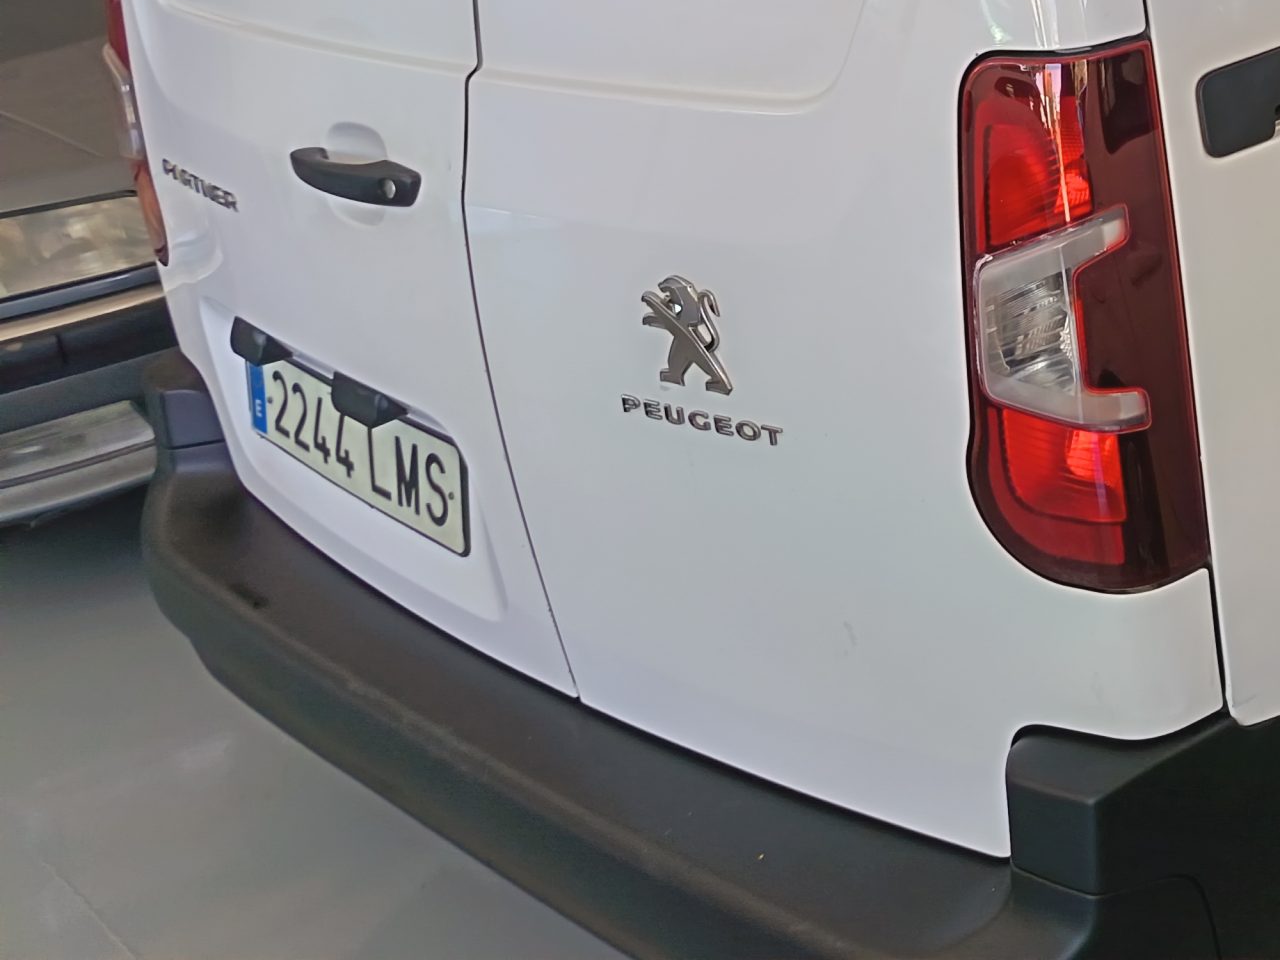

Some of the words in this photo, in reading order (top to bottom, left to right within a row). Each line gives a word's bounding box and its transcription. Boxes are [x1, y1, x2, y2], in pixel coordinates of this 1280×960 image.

[272, 370, 354, 479] 2244
[368, 427, 449, 527] LMS
[621, 393, 784, 446] PEUGEOT
